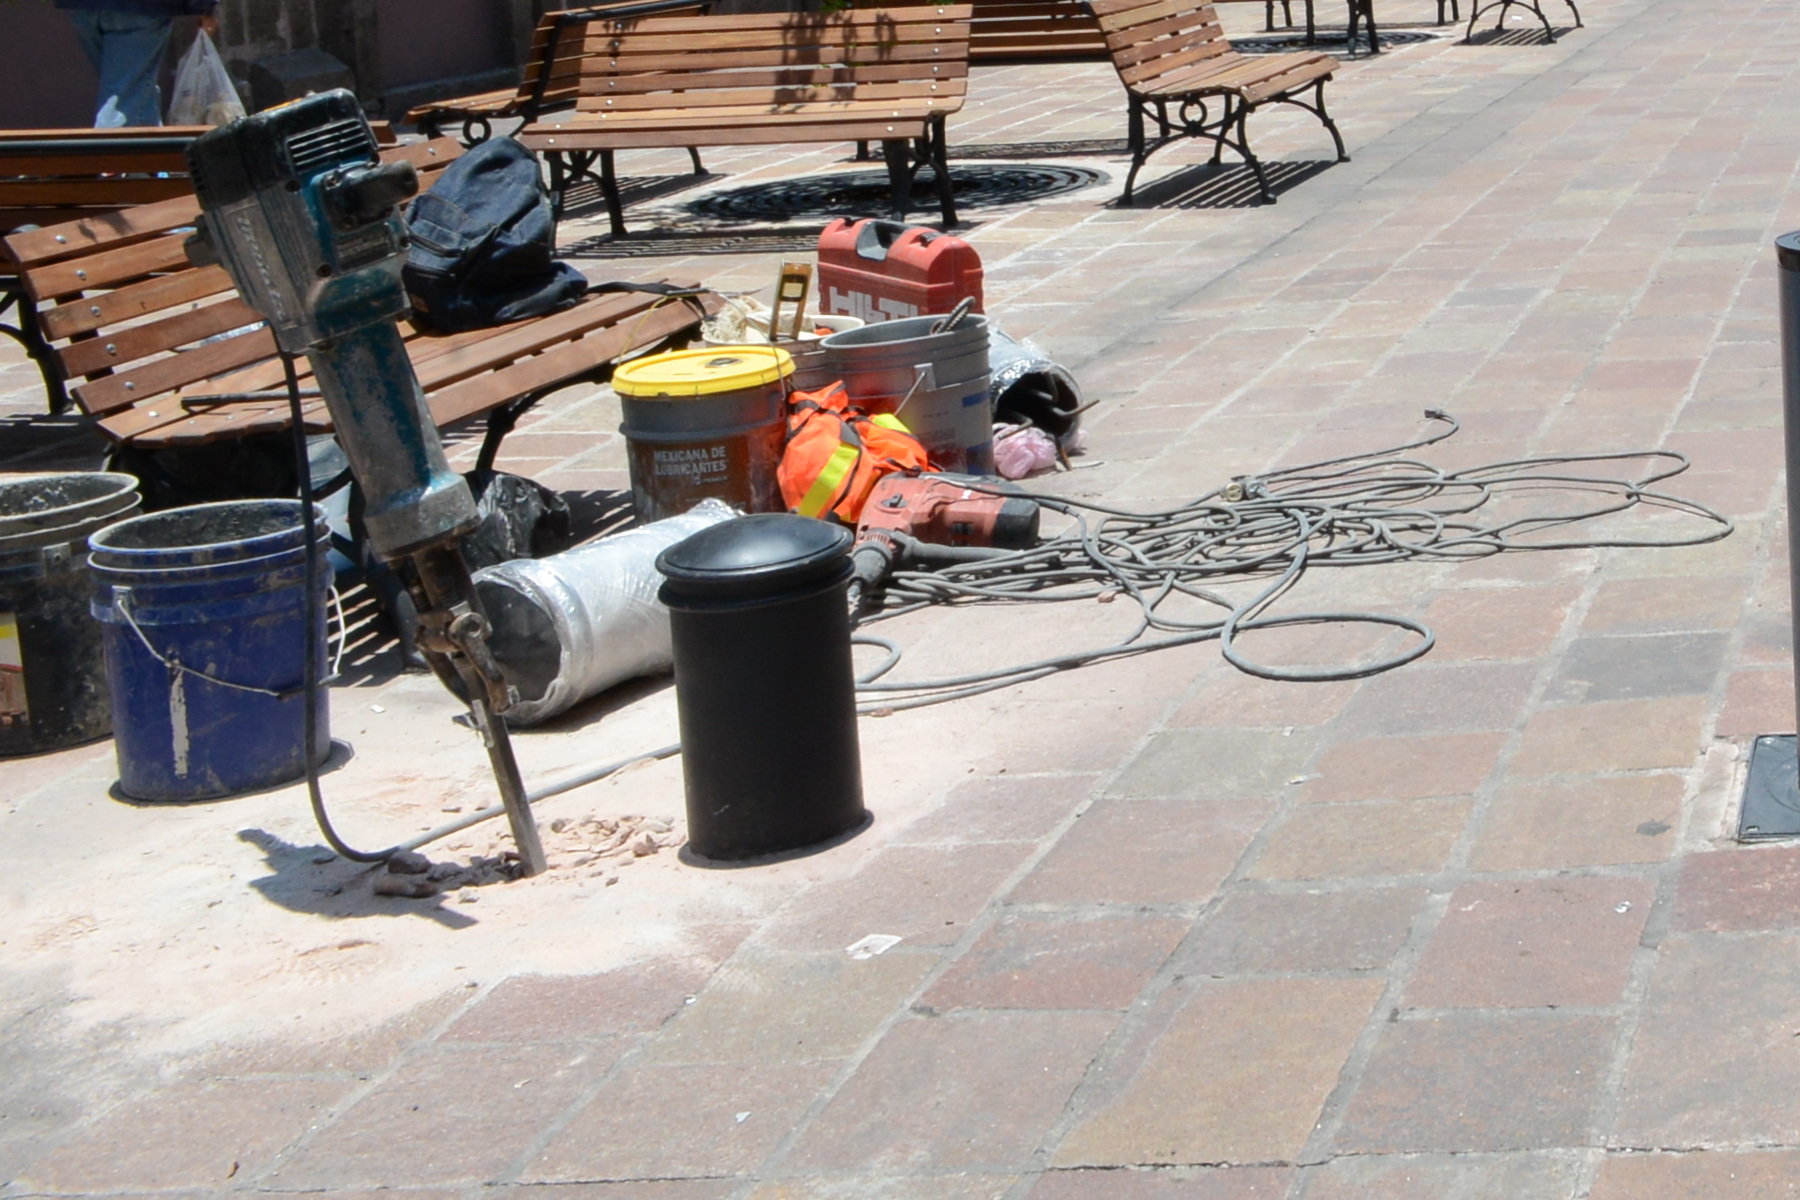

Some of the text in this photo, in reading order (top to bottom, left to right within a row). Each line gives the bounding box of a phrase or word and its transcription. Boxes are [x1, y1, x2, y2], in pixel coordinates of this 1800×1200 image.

[654, 446, 726, 462] MEXICANA DE
[655, 461, 727, 476] LUBRICANTES
